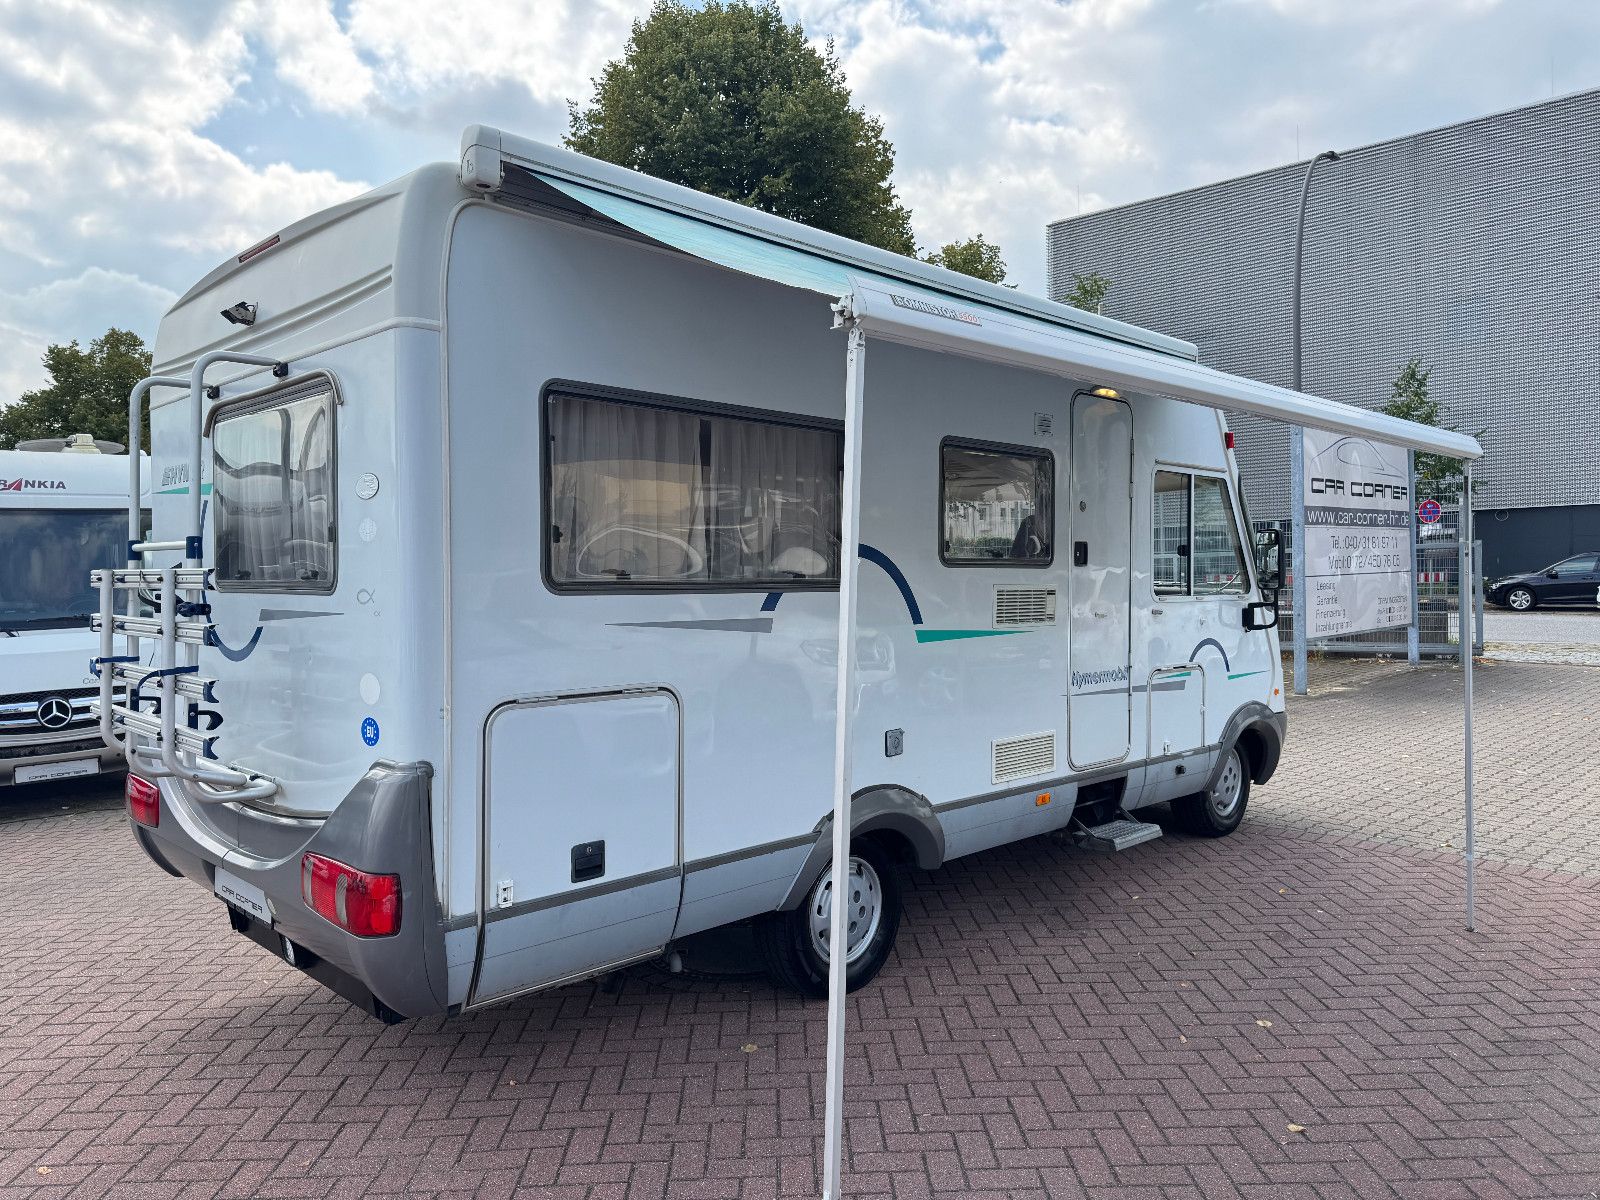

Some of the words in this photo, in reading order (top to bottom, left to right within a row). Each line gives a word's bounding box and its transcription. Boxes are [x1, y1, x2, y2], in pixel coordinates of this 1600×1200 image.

[0, 478, 66, 491] RANKIA
[1311, 477, 1345, 495] CAR
[1351, 481, 1408, 500] CORNER
